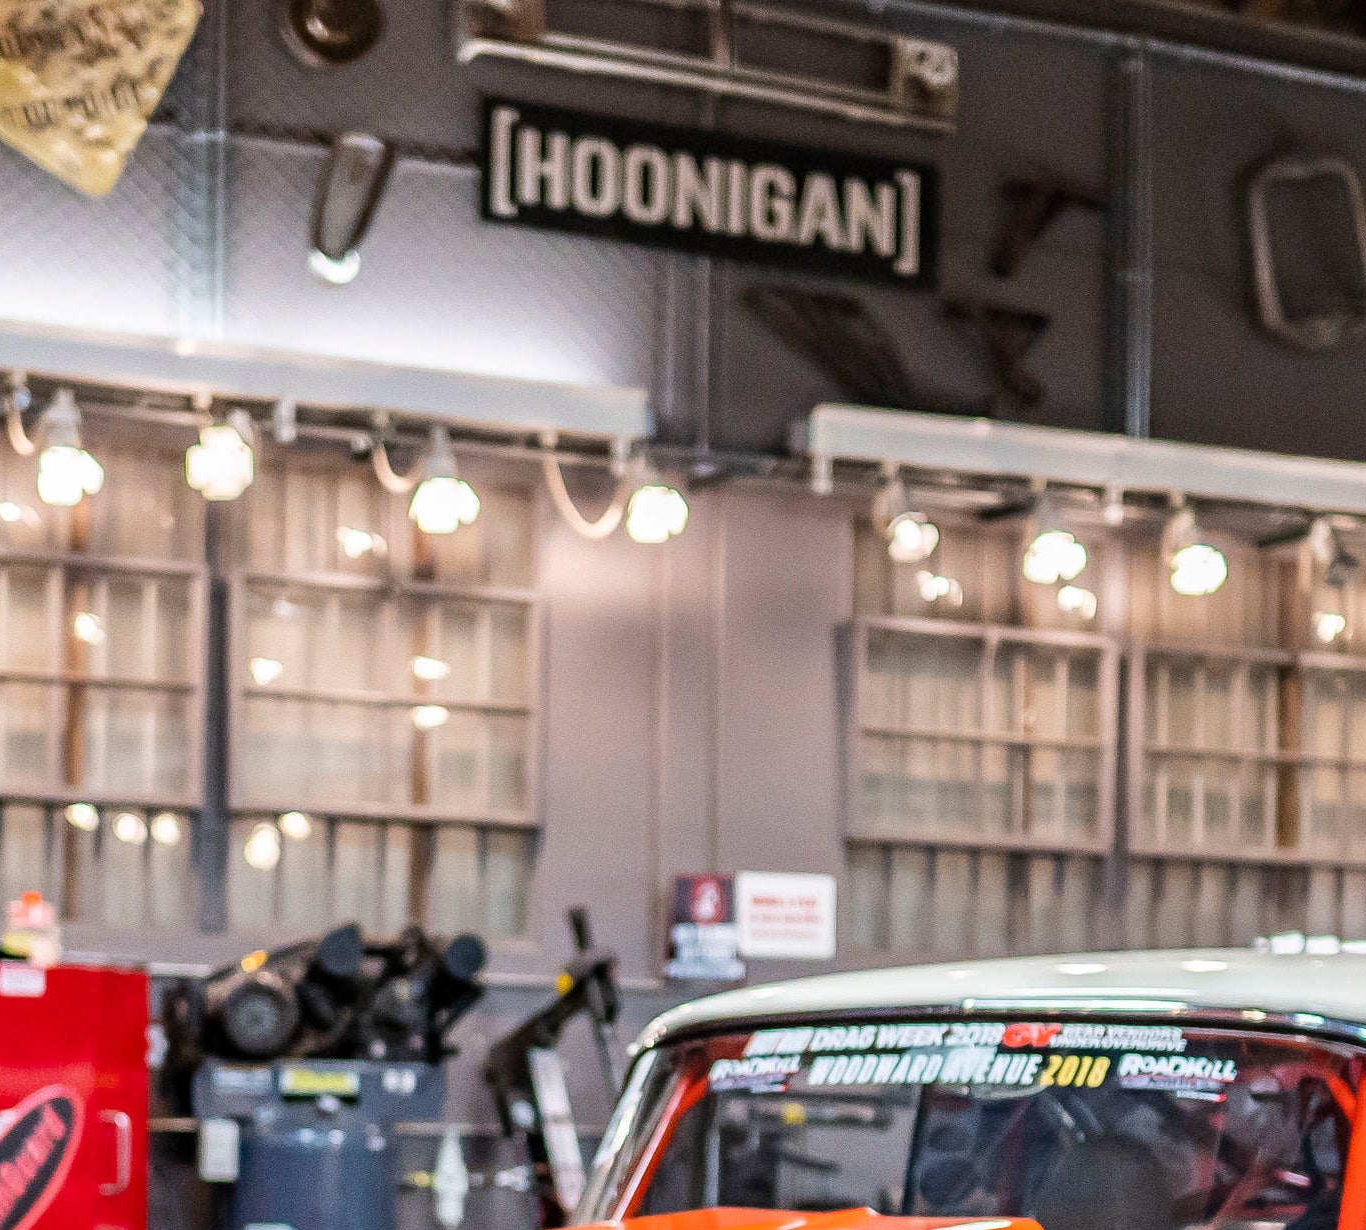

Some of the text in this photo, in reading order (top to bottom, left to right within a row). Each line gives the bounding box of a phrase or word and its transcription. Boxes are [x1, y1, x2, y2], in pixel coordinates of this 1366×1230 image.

[810, 1024, 878, 1052] DRAG
[876, 1023, 948, 1050] WEEK
[807, 1054, 945, 1087] WOODWARD
[938, 1050, 1043, 1087] AVENUE
[1039, 1053, 1111, 1089] 2018
